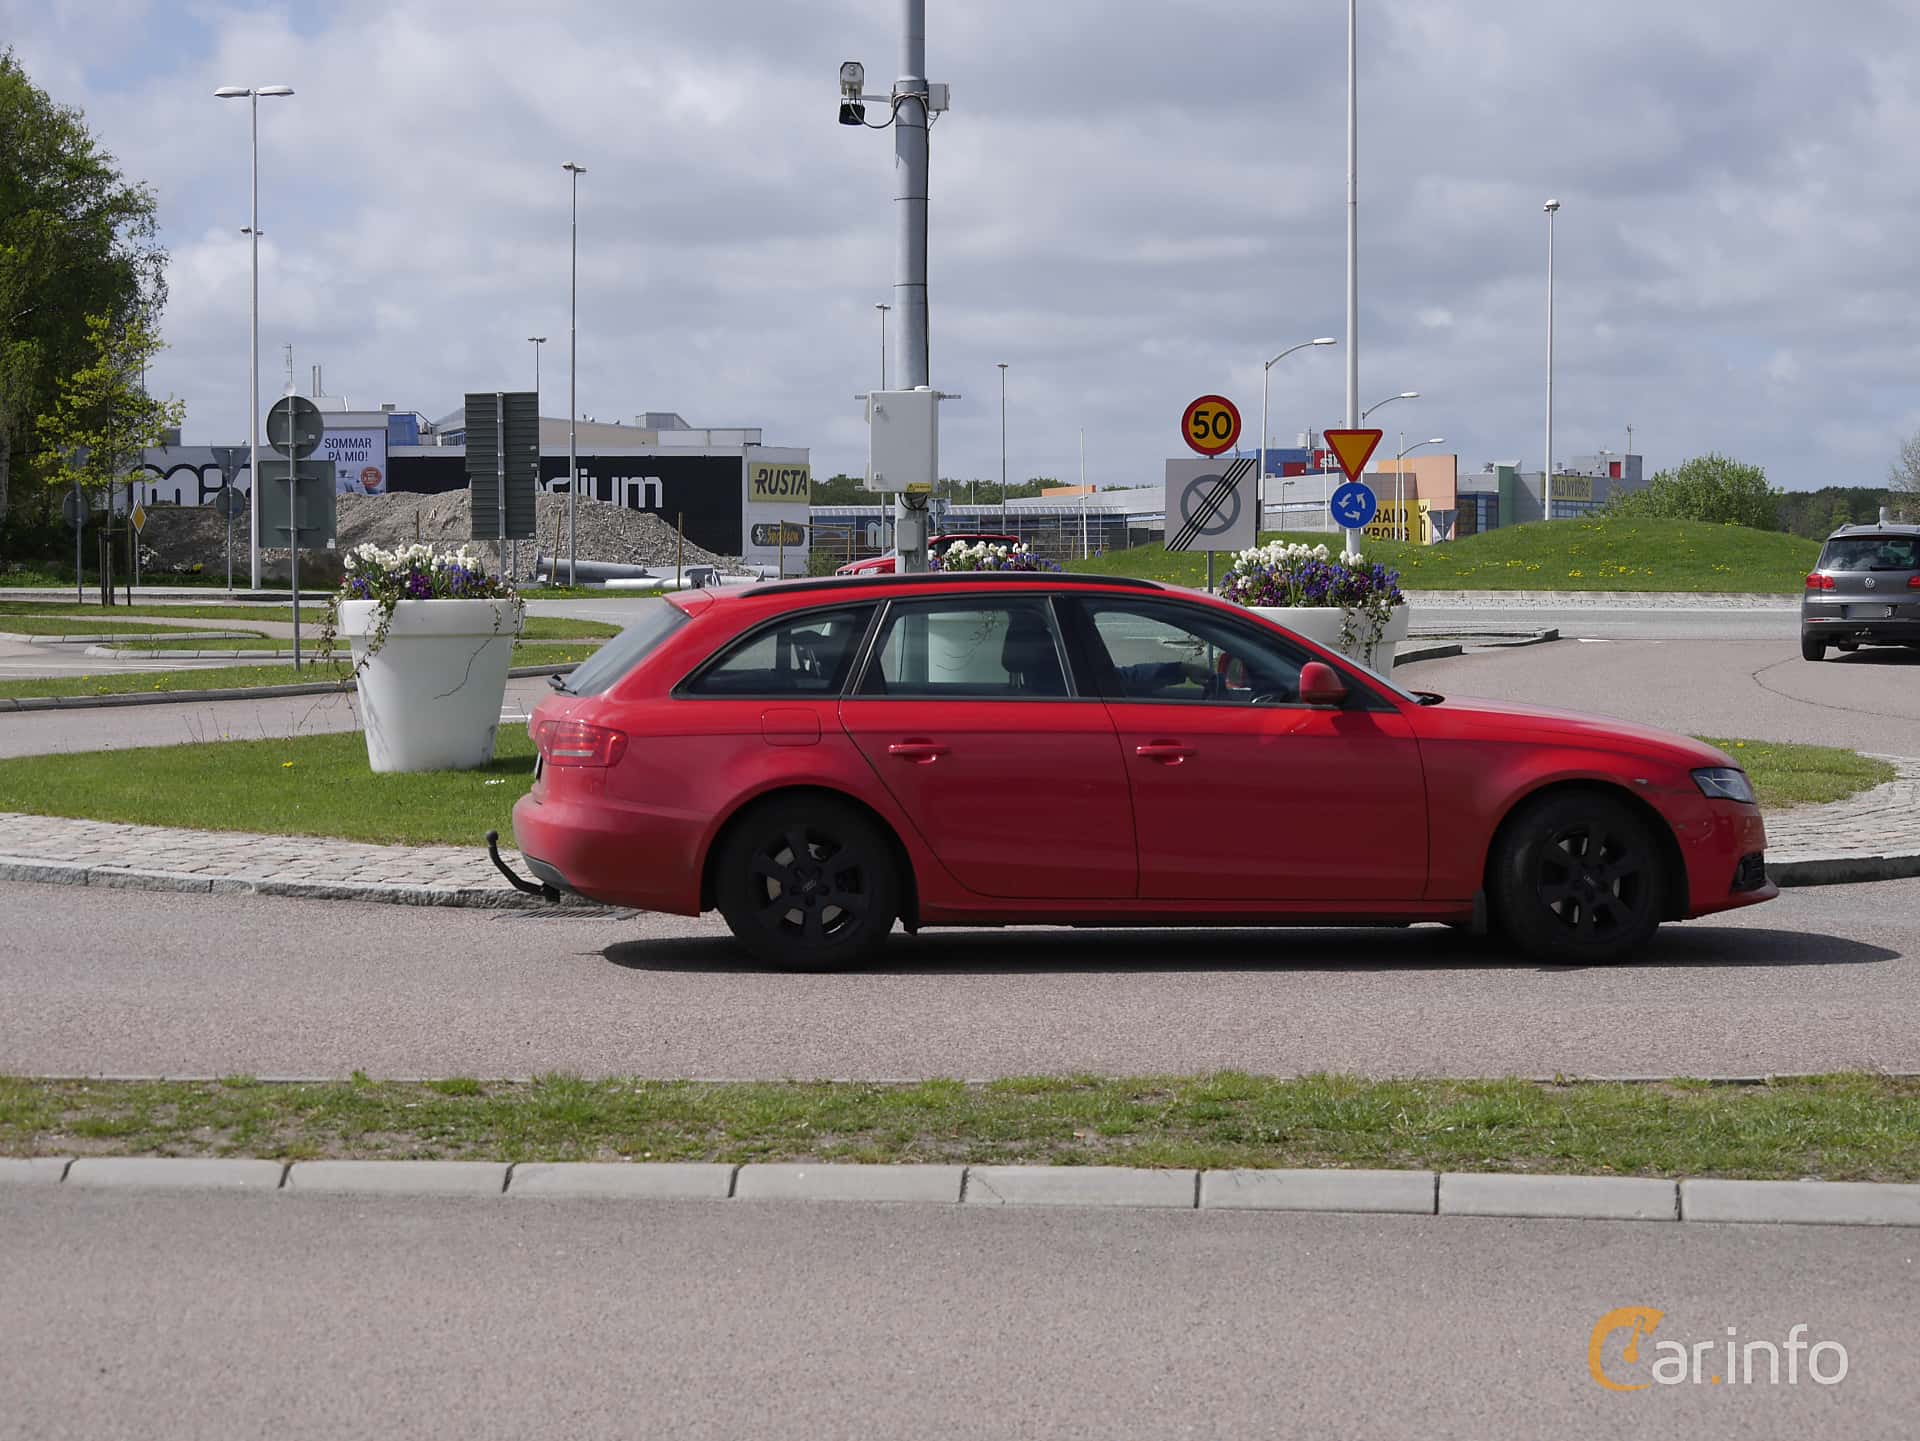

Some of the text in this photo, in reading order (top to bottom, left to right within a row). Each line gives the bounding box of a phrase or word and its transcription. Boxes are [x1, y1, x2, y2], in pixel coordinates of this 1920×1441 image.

[1192, 410, 1232, 440] 50
[324, 437, 372, 449] SOMMAR
[328, 449, 368, 462] PÅ MIO!
[755, 468, 808, 496] RUSTA
